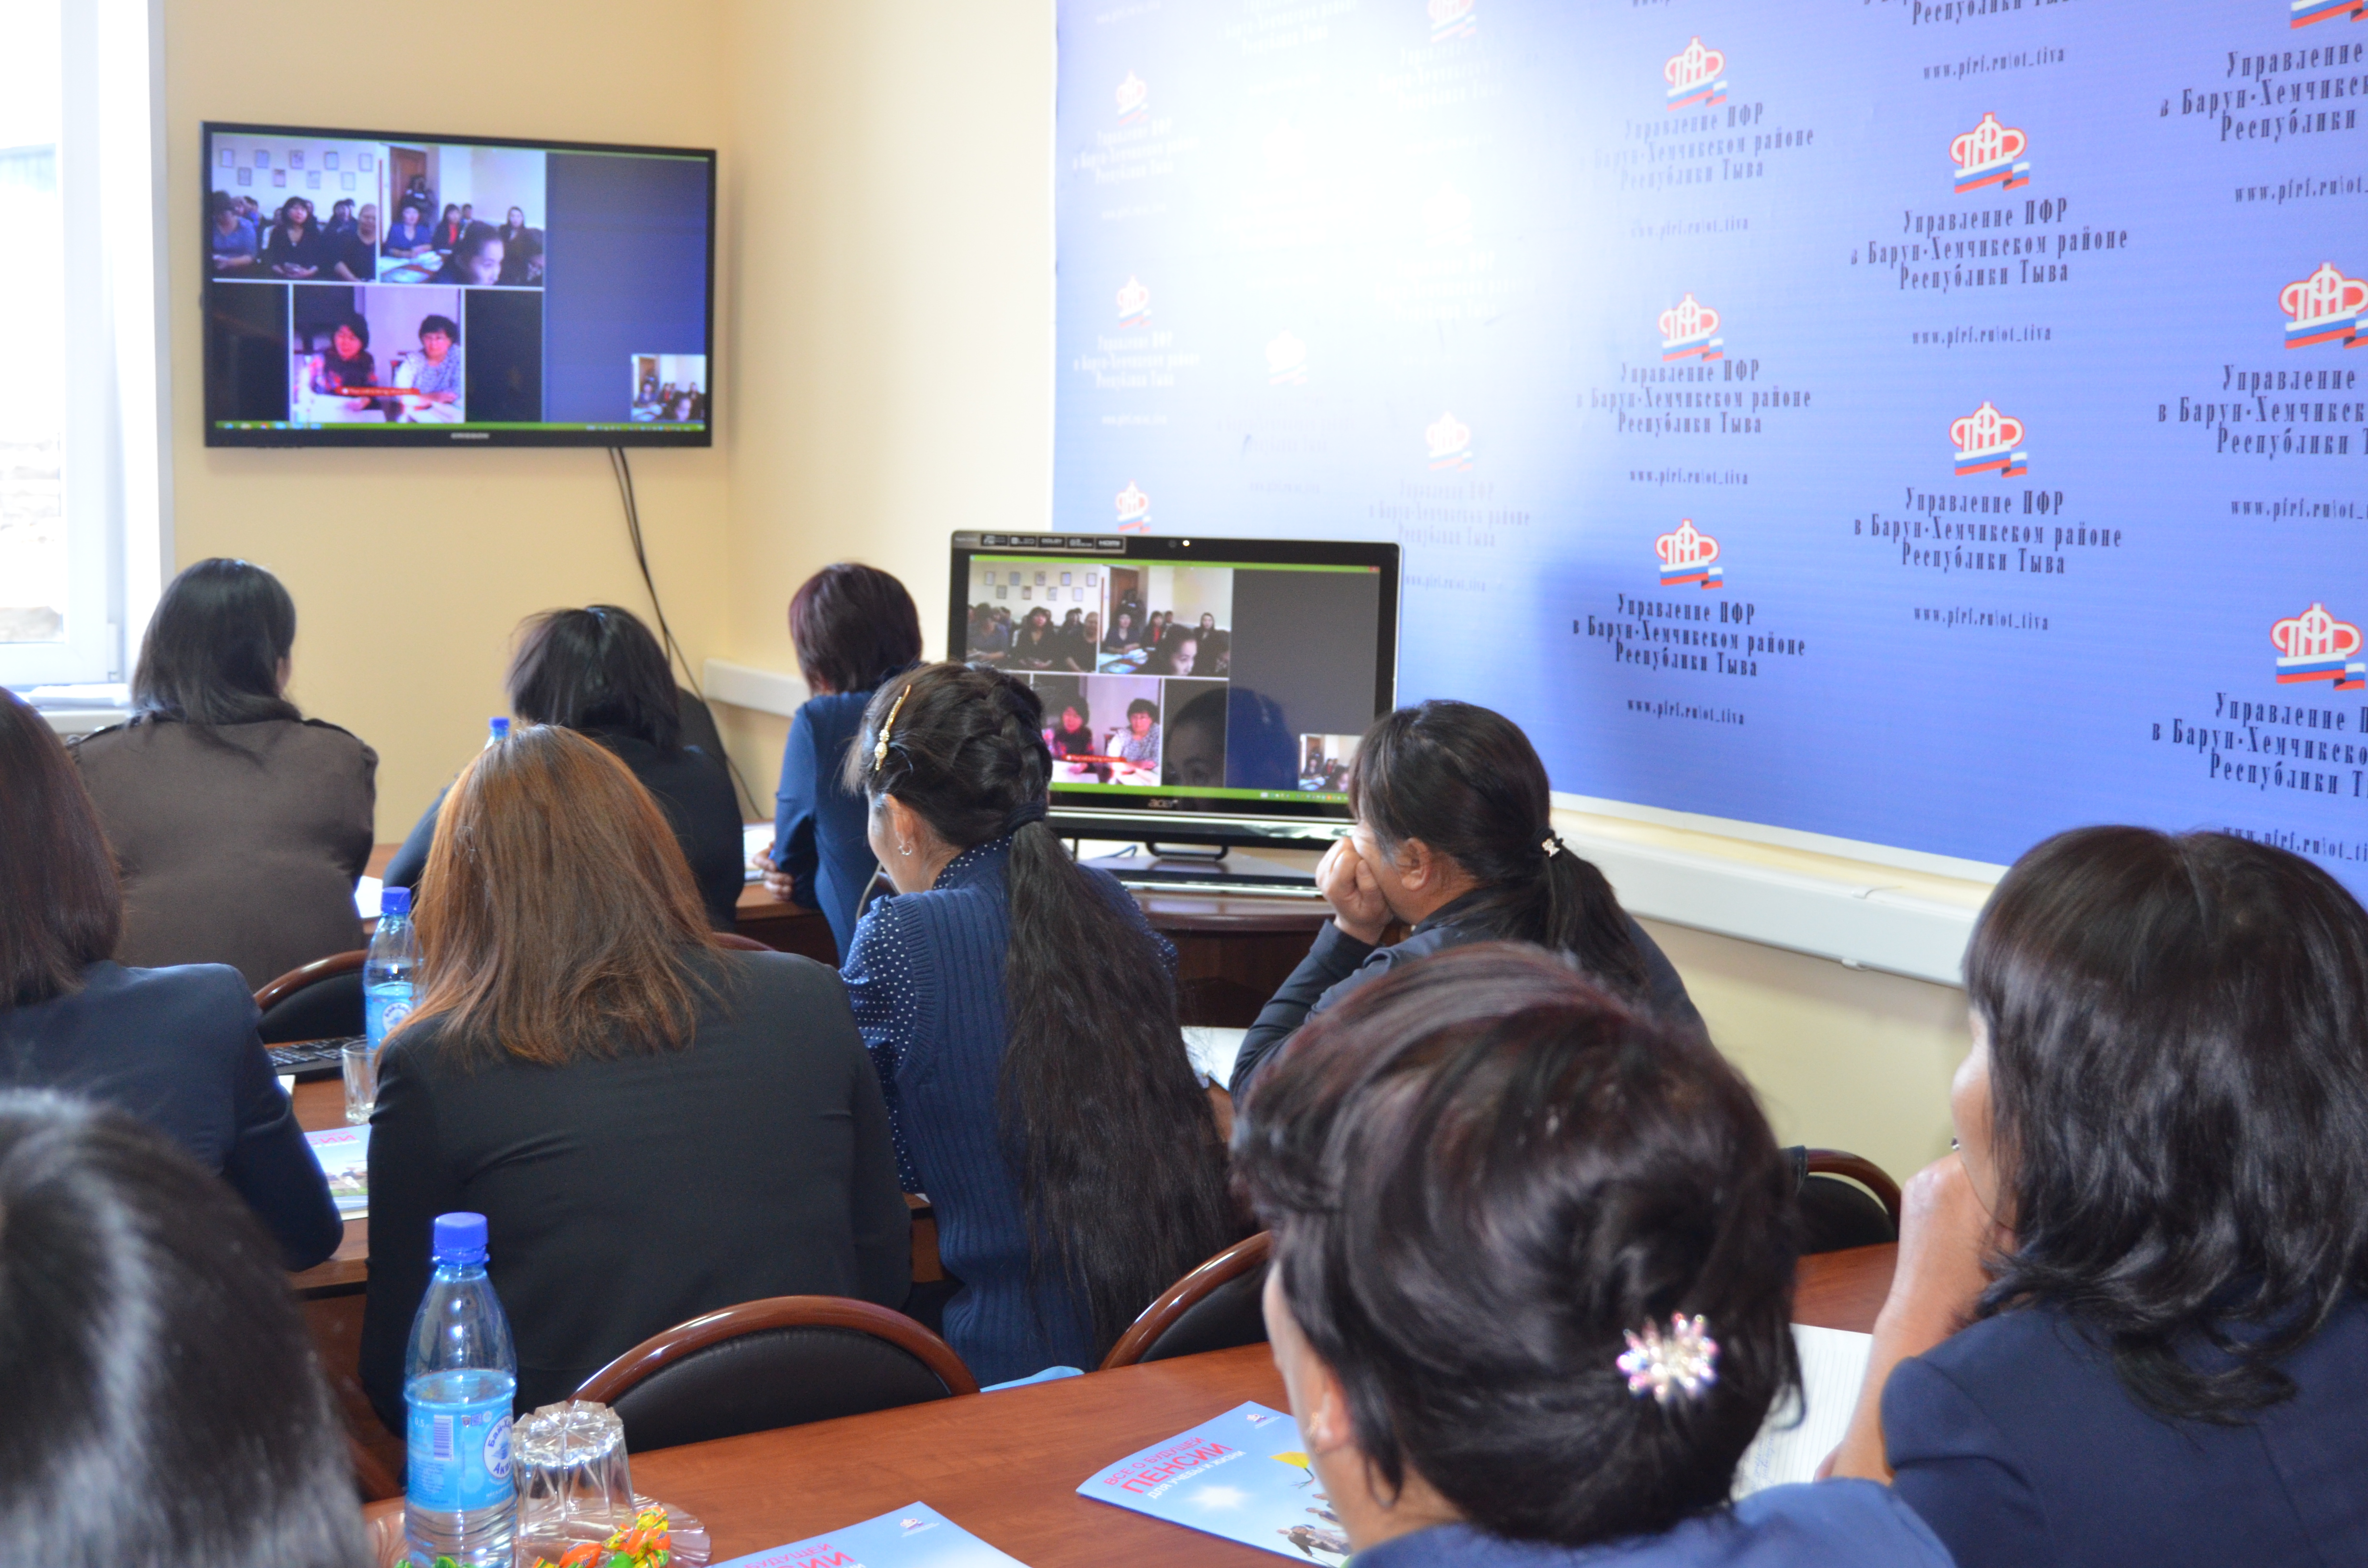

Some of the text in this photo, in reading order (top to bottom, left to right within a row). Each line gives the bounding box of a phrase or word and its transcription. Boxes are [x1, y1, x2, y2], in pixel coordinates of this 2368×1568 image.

[2227, 42, 2363, 83] Управление
[2160, 98, 2169, 117] в
[2220, 108, 2356, 143] Республики
[1904, 197, 2067, 238] Управление ПФР
[2058, 225, 2127, 259] районе
[1900, 259, 2068, 294] Республики Тыва
[1621, 359, 1760, 388] Управление ПФР
[2222, 365, 2356, 398] Управление
[1752, 385, 1811, 413] районе
[2158, 403, 2167, 422] в
[1618, 408, 1762, 438] Республики Тыва
[2216, 424, 2349, 460] Республики
[1906, 487, 2064, 517] Управление ПФР
[2055, 521, 2121, 551] районе
[1902, 537, 2065, 574] Республики Тыва
[1618, 593, 1755, 625] Управление ПФР
[1616, 638, 1757, 677] Республики Тыва
[1748, 631, 1805, 657] районе
[2215, 692, 2345, 731] Управление
[2152, 723, 2160, 741] в
[2209, 748, 2338, 796] Республики
[1104, 1468, 1135, 1485] ВСЕ
[1143, 1437, 1207, 1464] БУДУЩЕЙ
[1121, 1443, 1233, 1494] ПЕНСИИ
[1147, 1483, 1172, 1499] ДЛЯ
[1167, 1466, 1206, 1485] УЧЕБЫ
[1210, 1450, 1247, 1466] ЖИЗНИ
